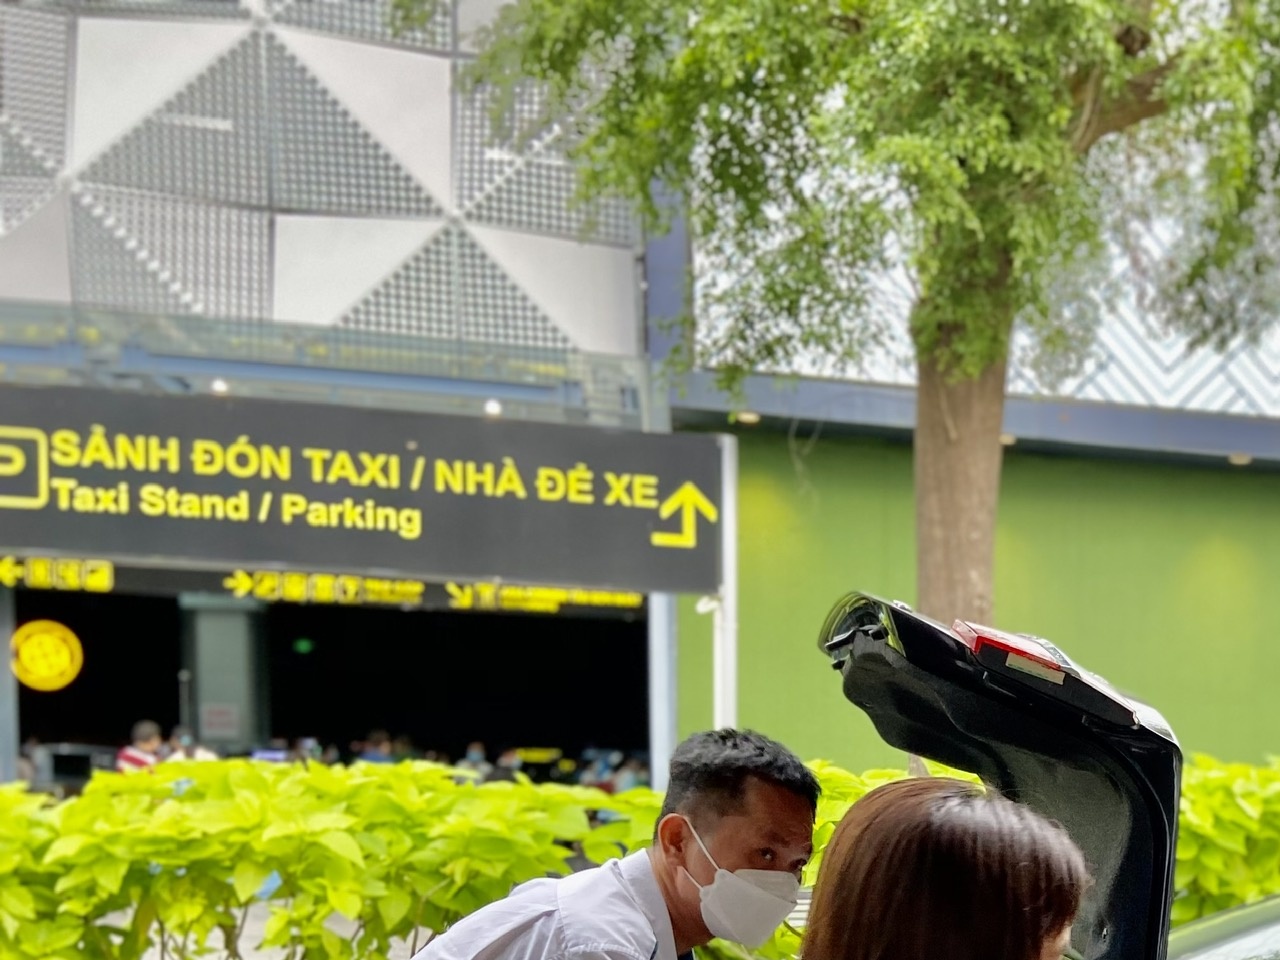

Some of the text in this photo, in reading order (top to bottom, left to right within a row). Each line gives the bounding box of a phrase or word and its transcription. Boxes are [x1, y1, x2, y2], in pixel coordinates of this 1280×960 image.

[50, 424, 181, 474] SẢNH
[190, 435, 292, 481] ĐÓN
[303, 448, 400, 489] TAXI
[434, 456, 528, 500] NHÀ
[603, 471, 660, 509] XE
[50, 477, 131, 515] Taxi
[139, 483, 251, 522] Stand
[281, 492, 423, 540] Parking
